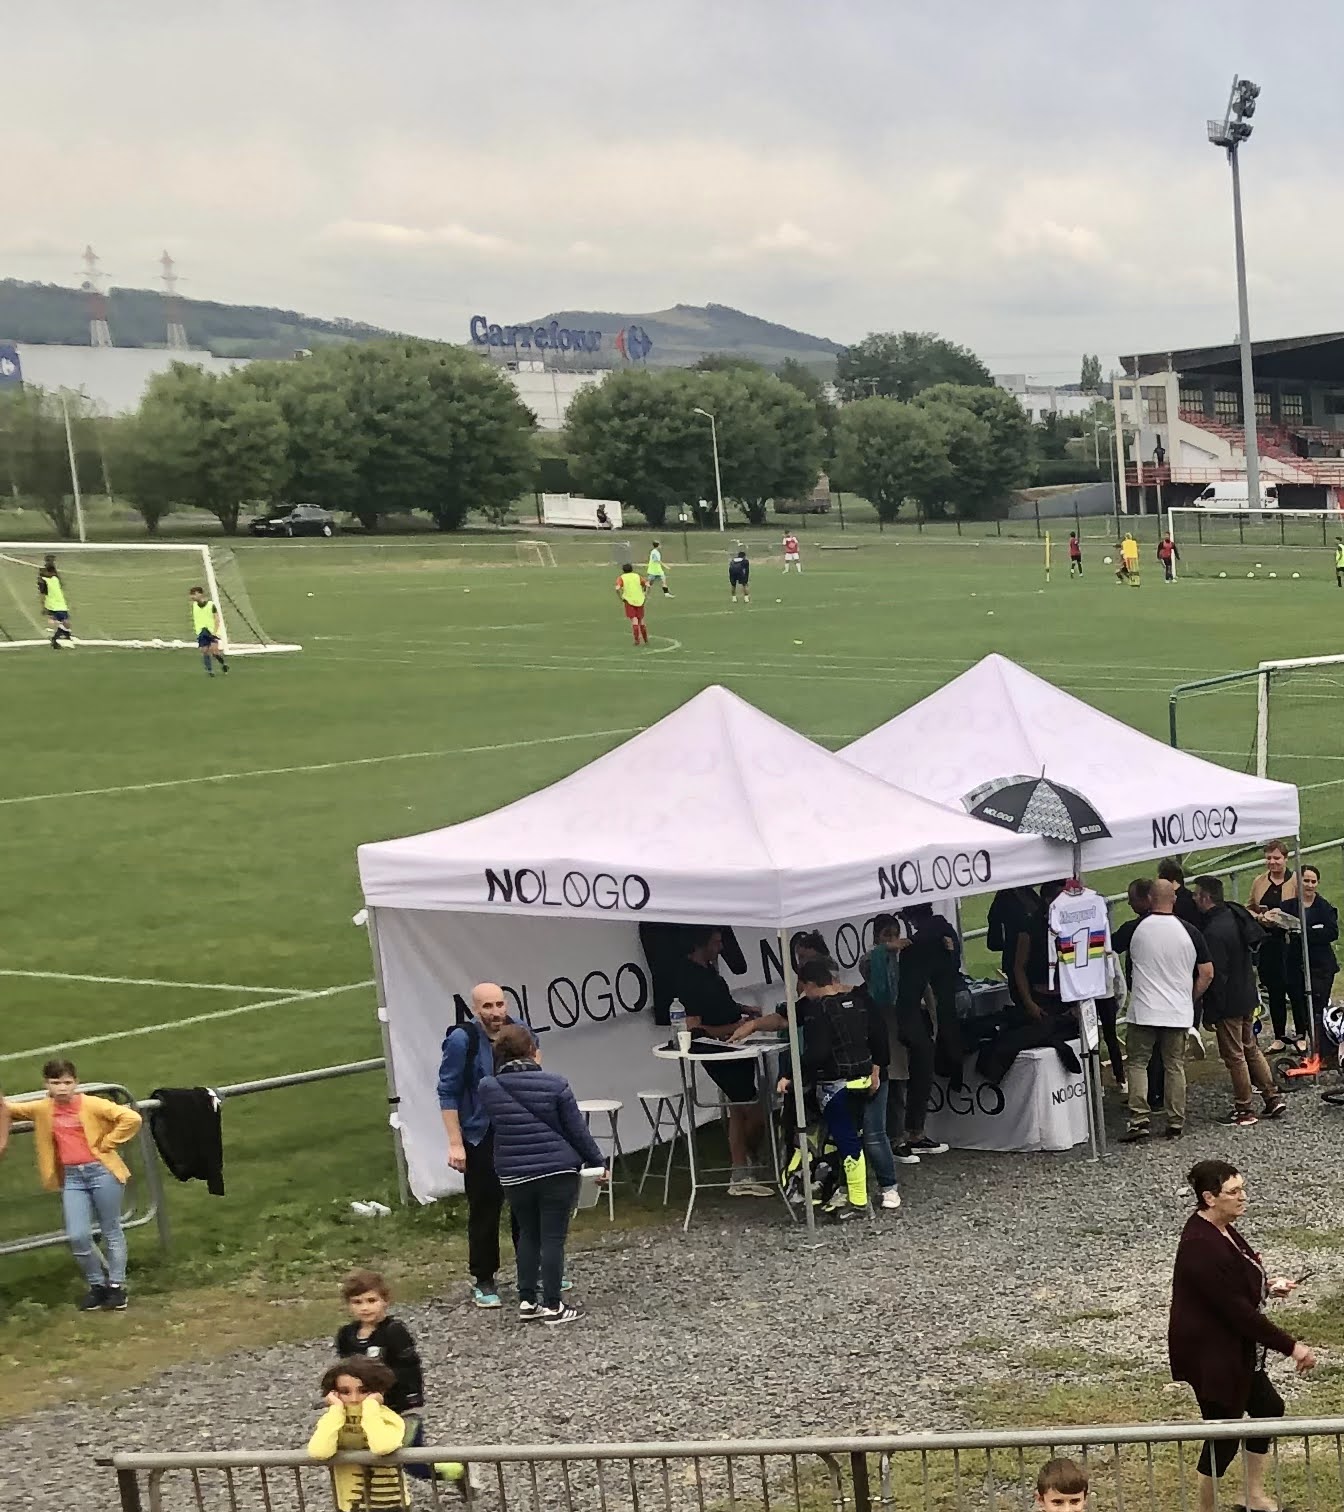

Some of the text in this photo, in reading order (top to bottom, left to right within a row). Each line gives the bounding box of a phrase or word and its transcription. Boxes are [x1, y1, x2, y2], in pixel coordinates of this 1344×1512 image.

[469, 315, 602, 351] Carrefour
[983, 806, 1015, 823] NOLOGO
[1151, 805, 1238, 849] NOLOGO
[485, 868, 650, 910] NOLOGO
[878, 849, 992, 900] NOLOGO
[1071, 926, 1090, 970] 1
[926, 1080, 1006, 1116] OGO
